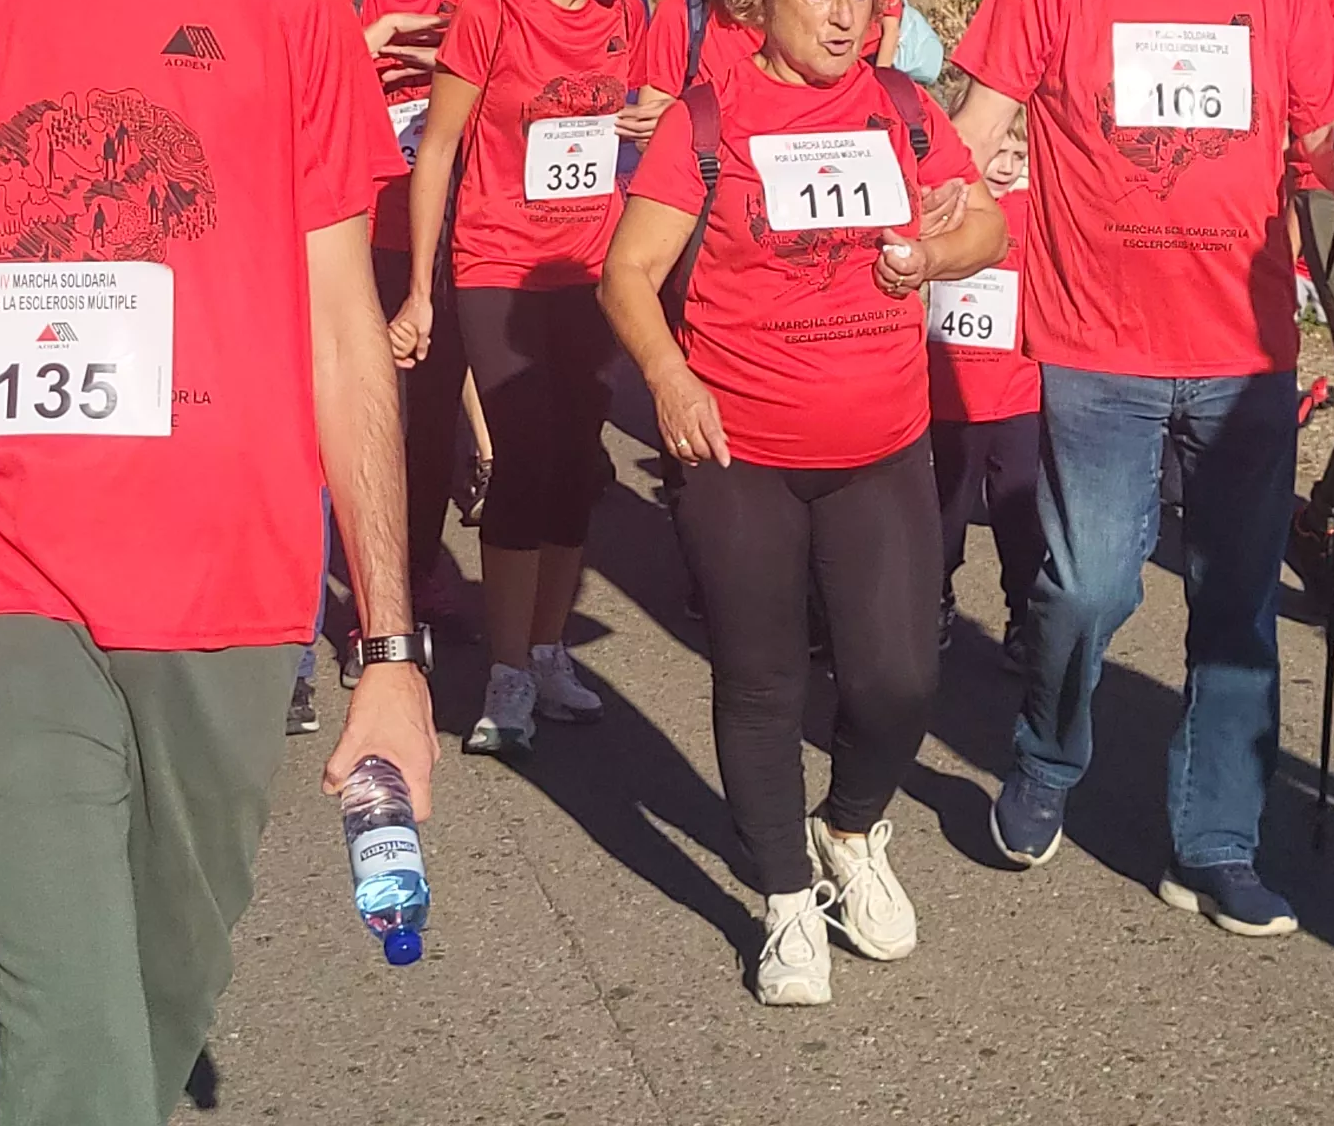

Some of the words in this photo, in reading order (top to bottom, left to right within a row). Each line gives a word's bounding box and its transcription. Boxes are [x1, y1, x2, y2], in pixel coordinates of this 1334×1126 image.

[1149, 83, 1221, 118] 106
[547, 162, 597, 191] 335
[800, 182, 871, 218] 111
[1115, 223, 1162, 234] MARCHA
[0, 274, 10, 289] IV
[13, 274, 57, 288] MARCHA
[61, 273, 116, 288] SOLIDARIA
[3, 295, 16, 310] LA
[19, 295, 85, 310] ESCLEROSIS
[88, 292, 137, 310] MÚLTIPLE
[942, 311, 992, 339] 469
[194, 389, 211, 404] LA
